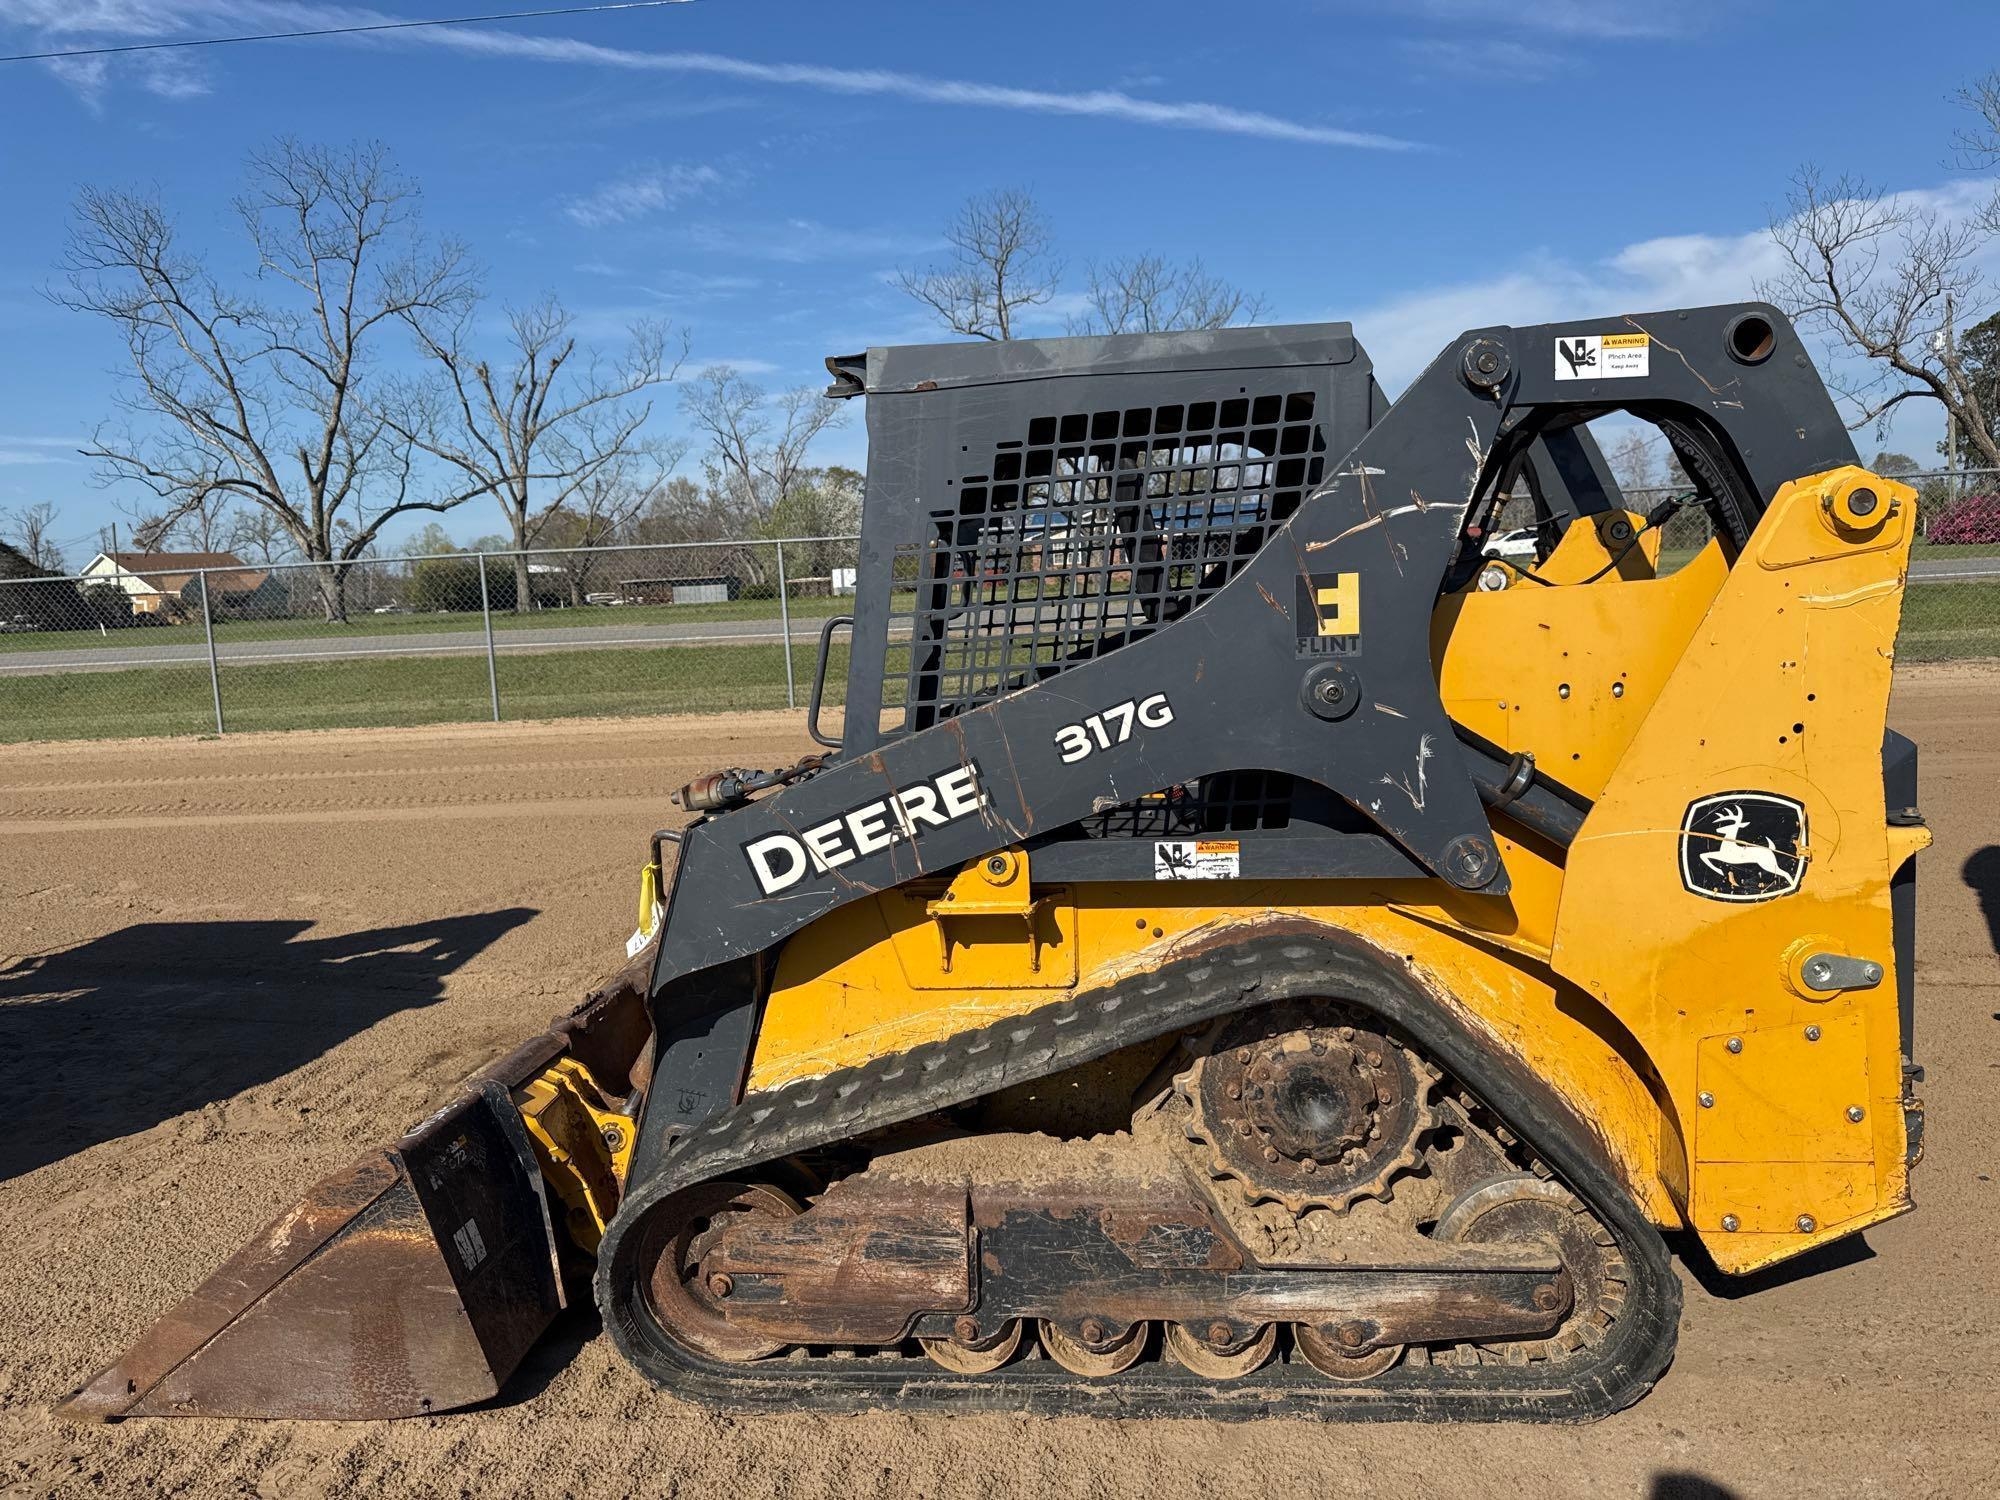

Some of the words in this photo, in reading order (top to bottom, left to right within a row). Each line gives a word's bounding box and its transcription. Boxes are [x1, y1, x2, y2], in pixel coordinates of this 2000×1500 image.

[1611, 337, 1645, 345] WARNING
[1298, 636, 1360, 654] FLINT
[1054, 693, 1175, 764] 317G
[744, 762, 988, 896] DEERE
[1204, 843, 1236, 851] WARNING
